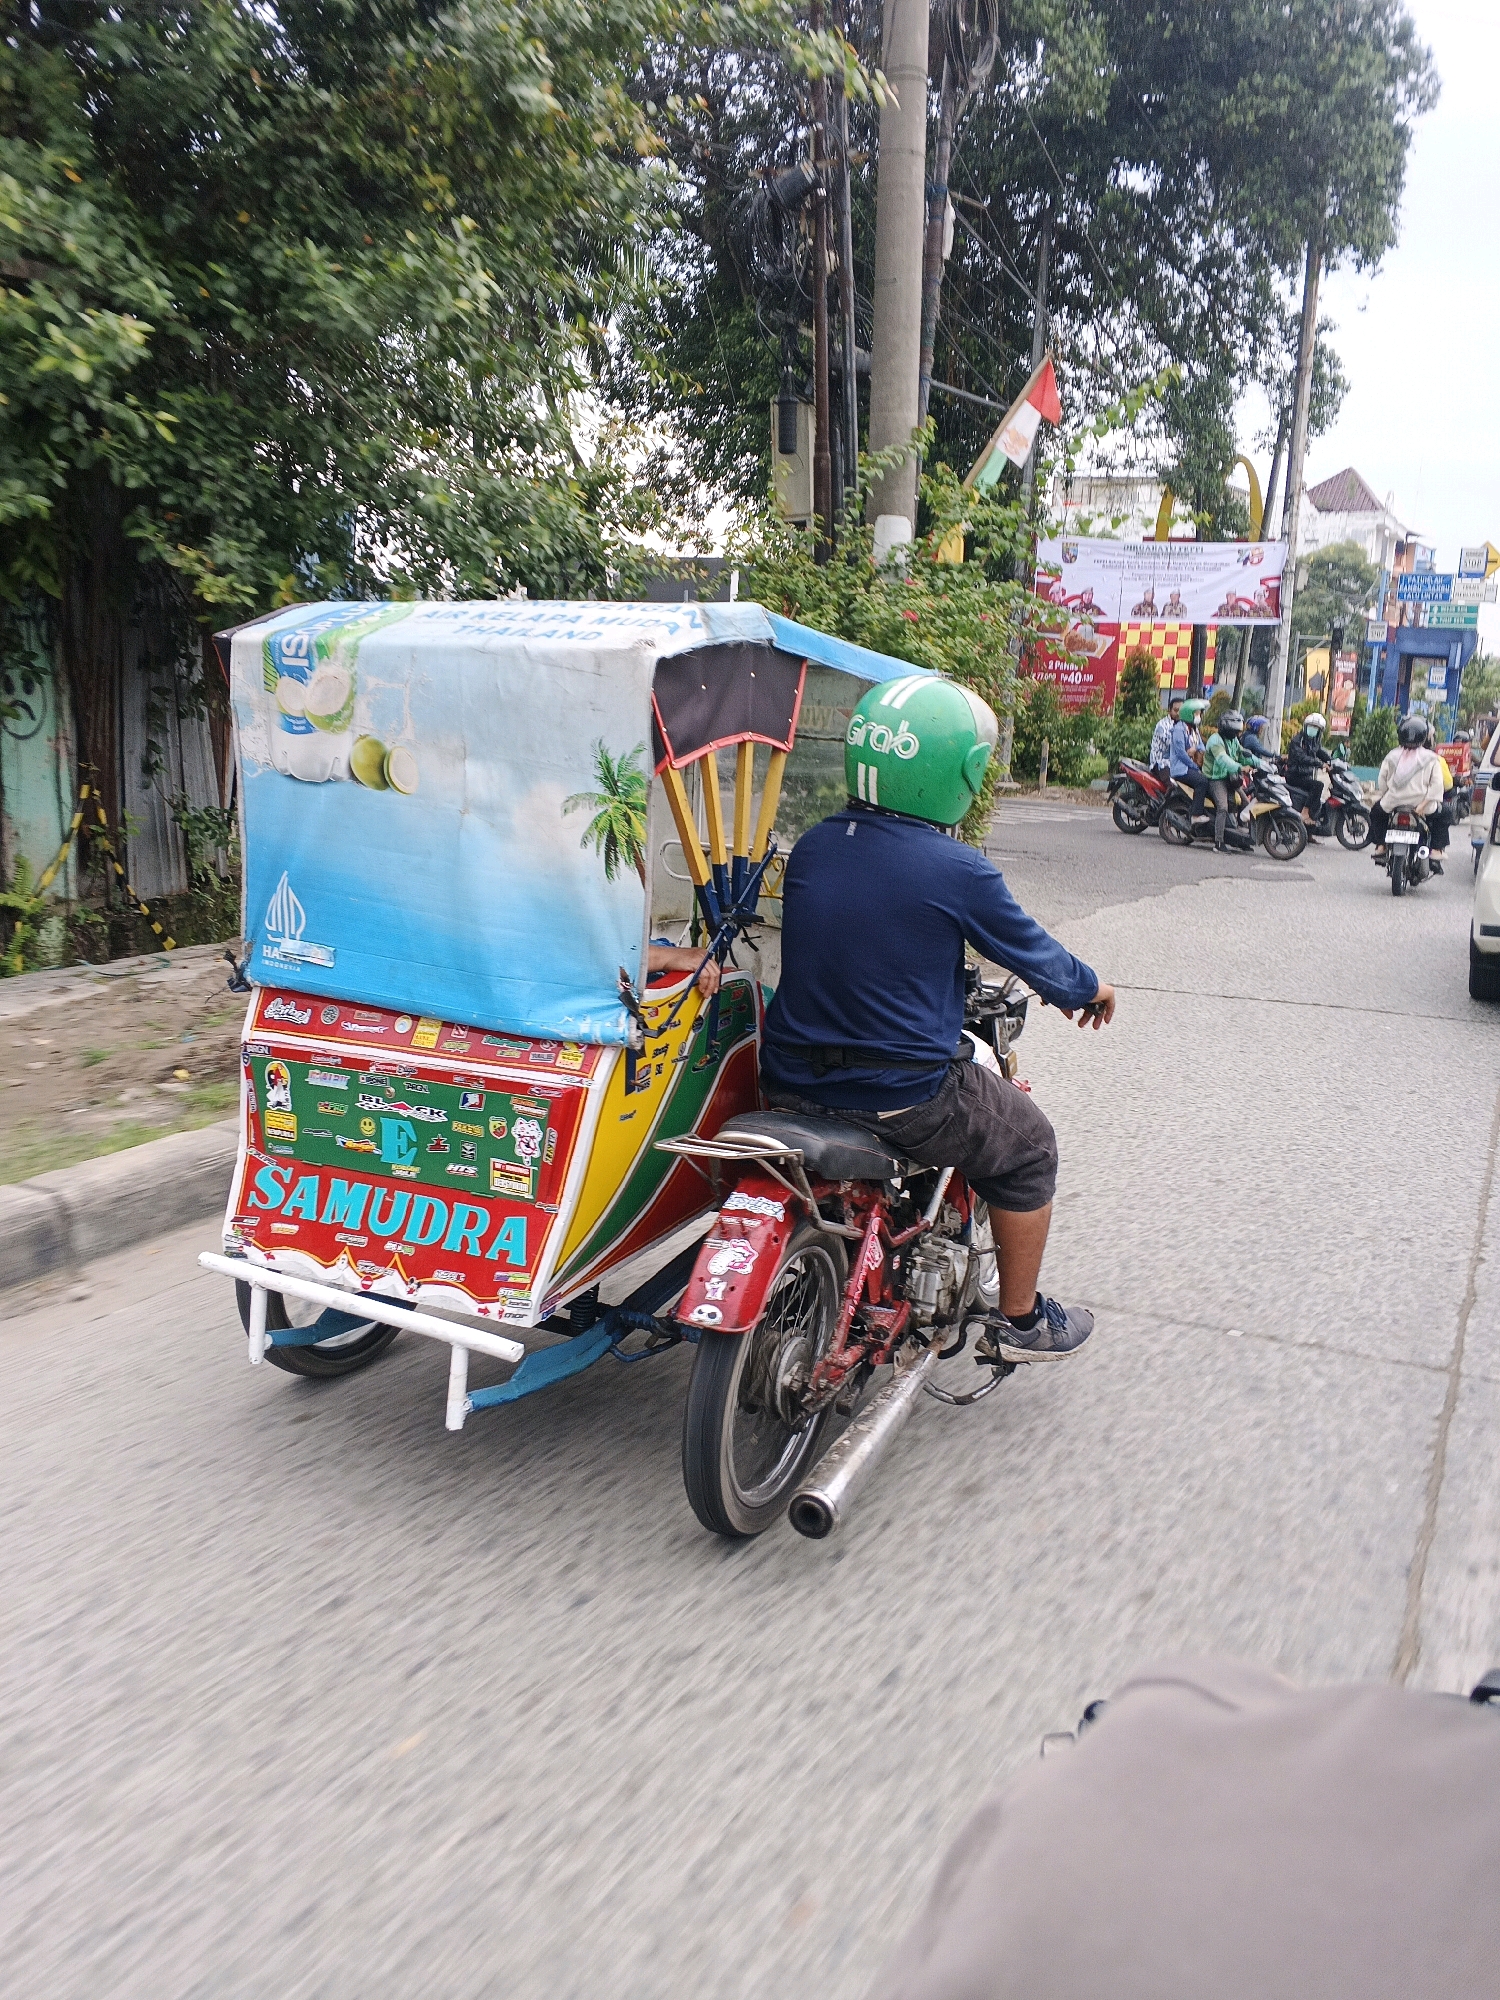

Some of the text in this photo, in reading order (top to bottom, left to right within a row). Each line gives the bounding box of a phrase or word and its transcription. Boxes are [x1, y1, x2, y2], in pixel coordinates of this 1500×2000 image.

[847, 714, 920, 760] Grab
[261, 959, 301, 972] INDONESIA
[379, 1116, 418, 1166] E
[246, 1164, 528, 1267] SAMUDRA
